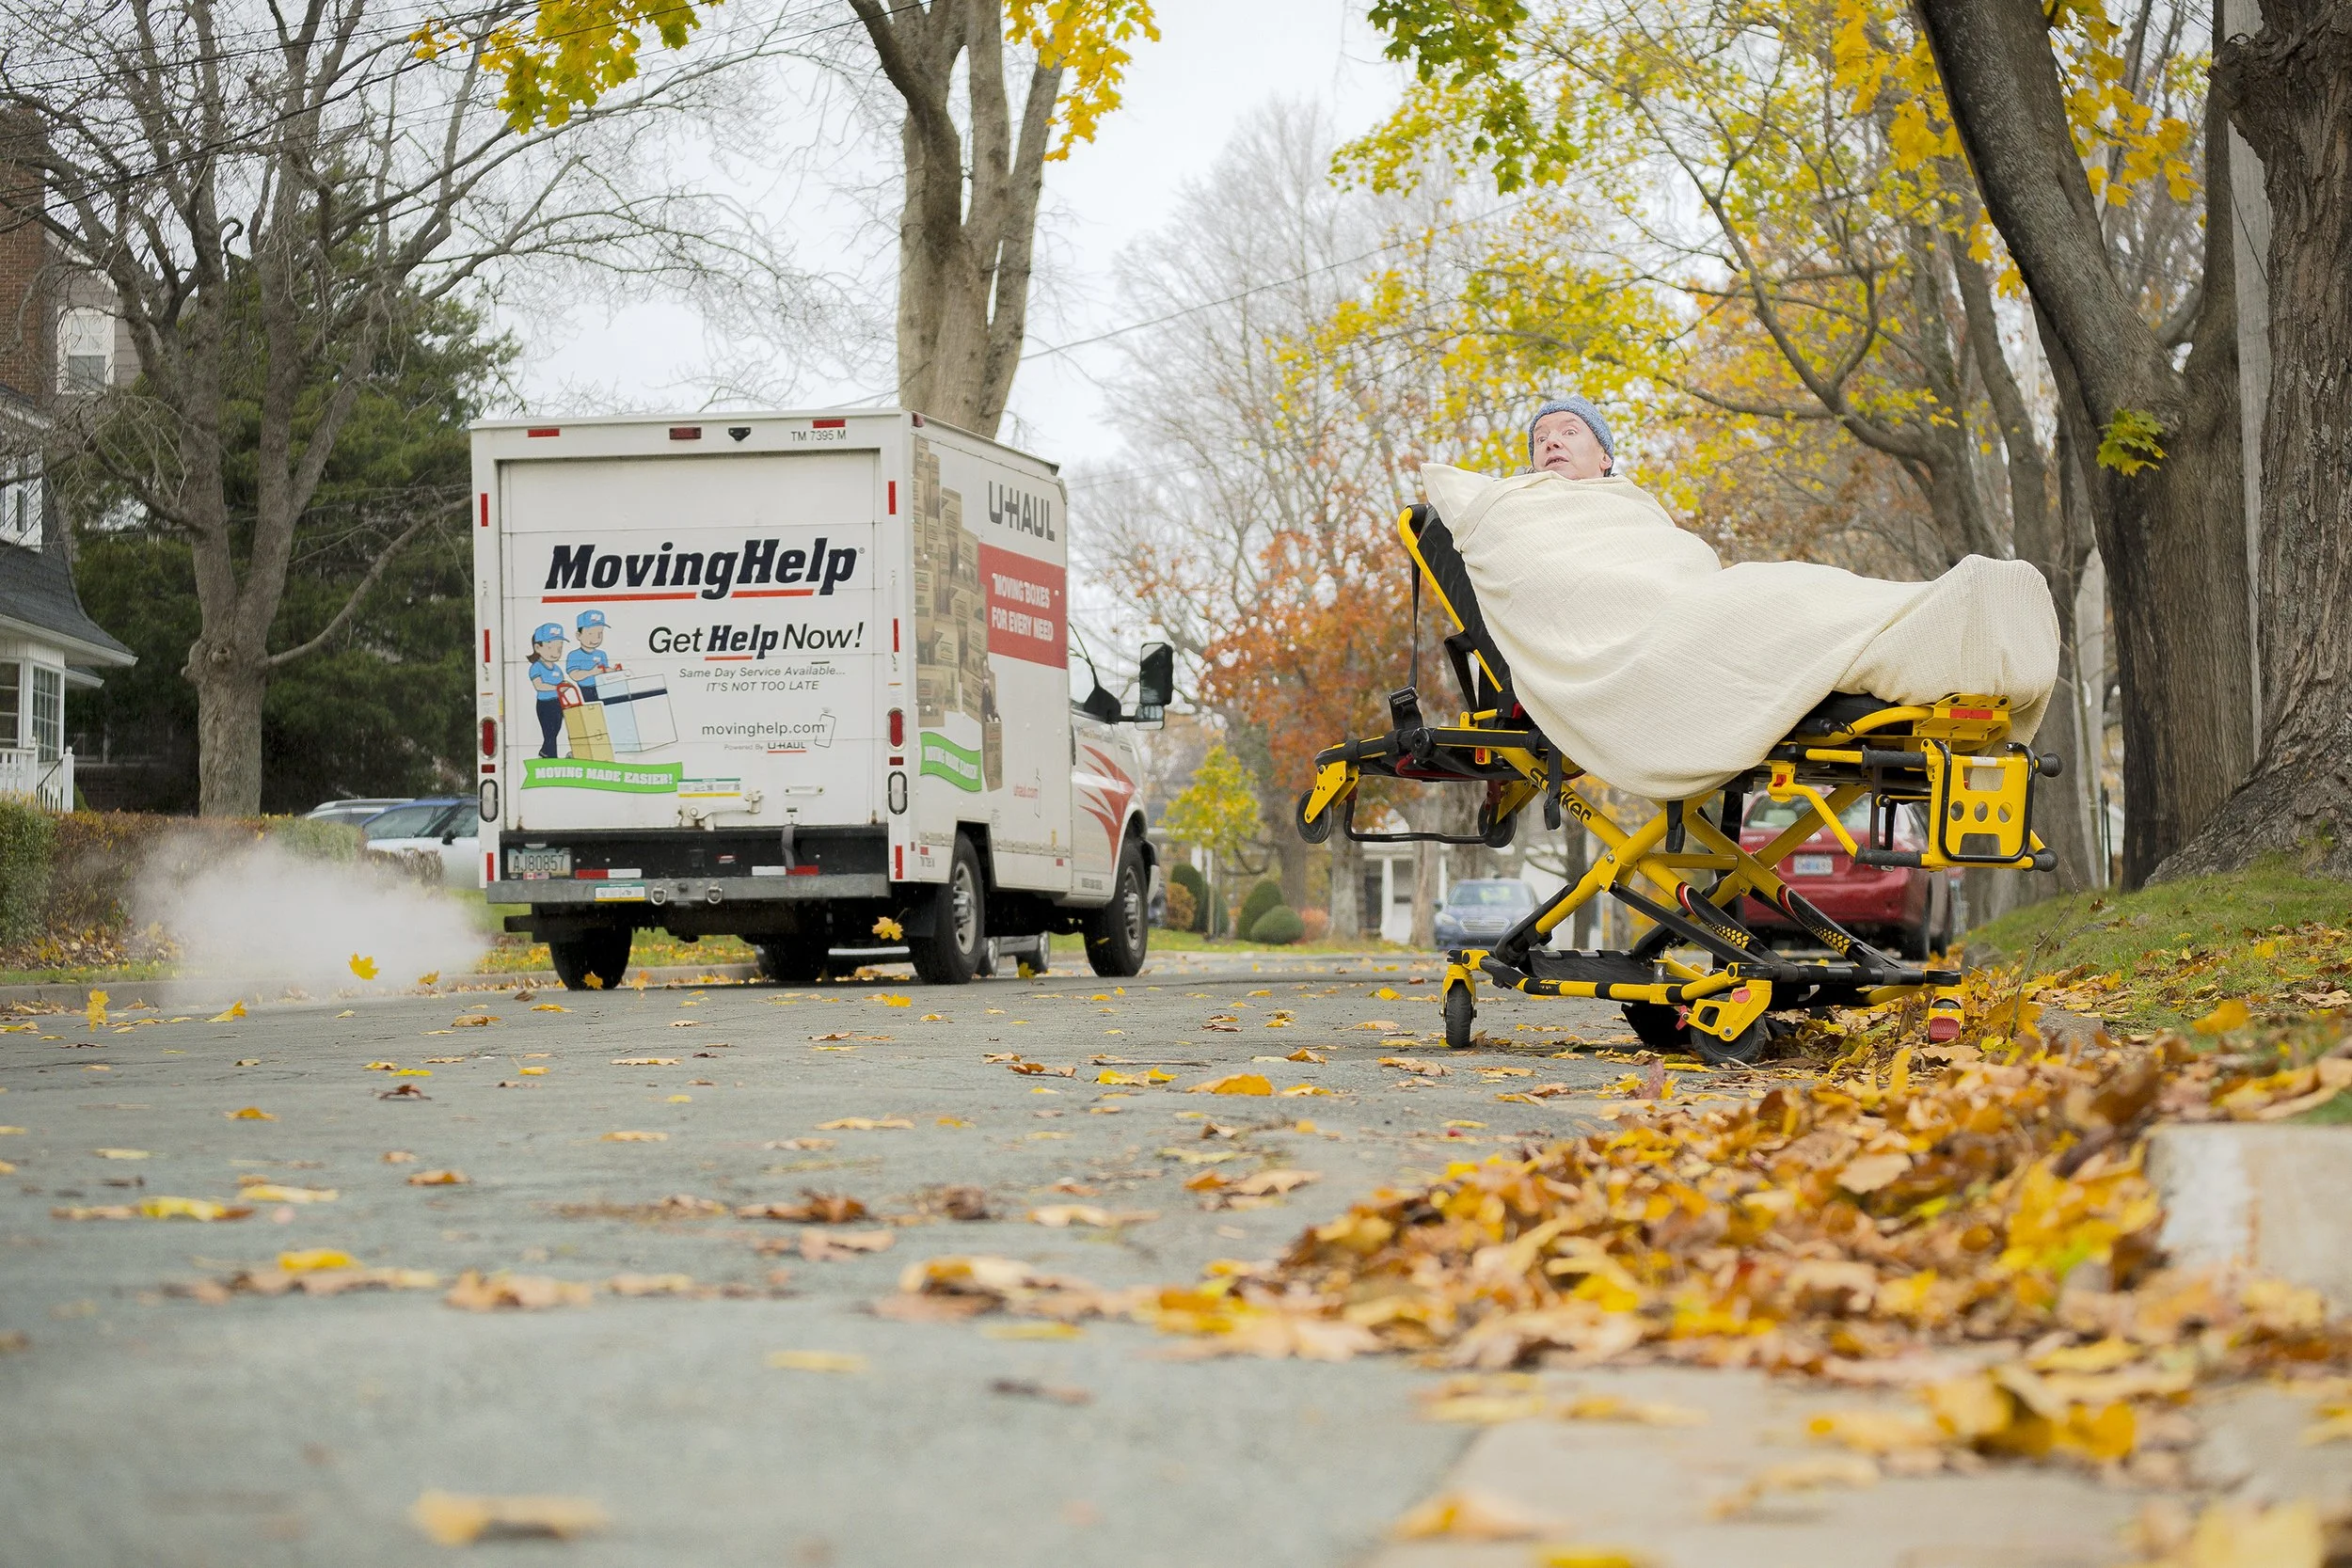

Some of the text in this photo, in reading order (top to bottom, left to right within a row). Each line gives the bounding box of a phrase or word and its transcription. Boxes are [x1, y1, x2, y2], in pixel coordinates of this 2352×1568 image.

[791, 429, 847, 441] TM 7395 M
[989, 481, 1056, 542] U-HAUL
[992, 573, 1051, 609] MOVING BOXES
[992, 606, 1008, 631] FOR
[1009, 610, 1032, 637] EVERY
[1033, 617, 1054, 641] NEED
[648, 622, 864, 659] Get Help Now!
[679, 666, 846, 678] Same Day Service Available...
[707, 680, 819, 691] IT'S NOT TOO LATE
[702, 722, 825, 736] movinghelp.com
[534, 767, 673, 784] MOVING MADE EASIER!
[513, 855, 564, 871] AJ80857
